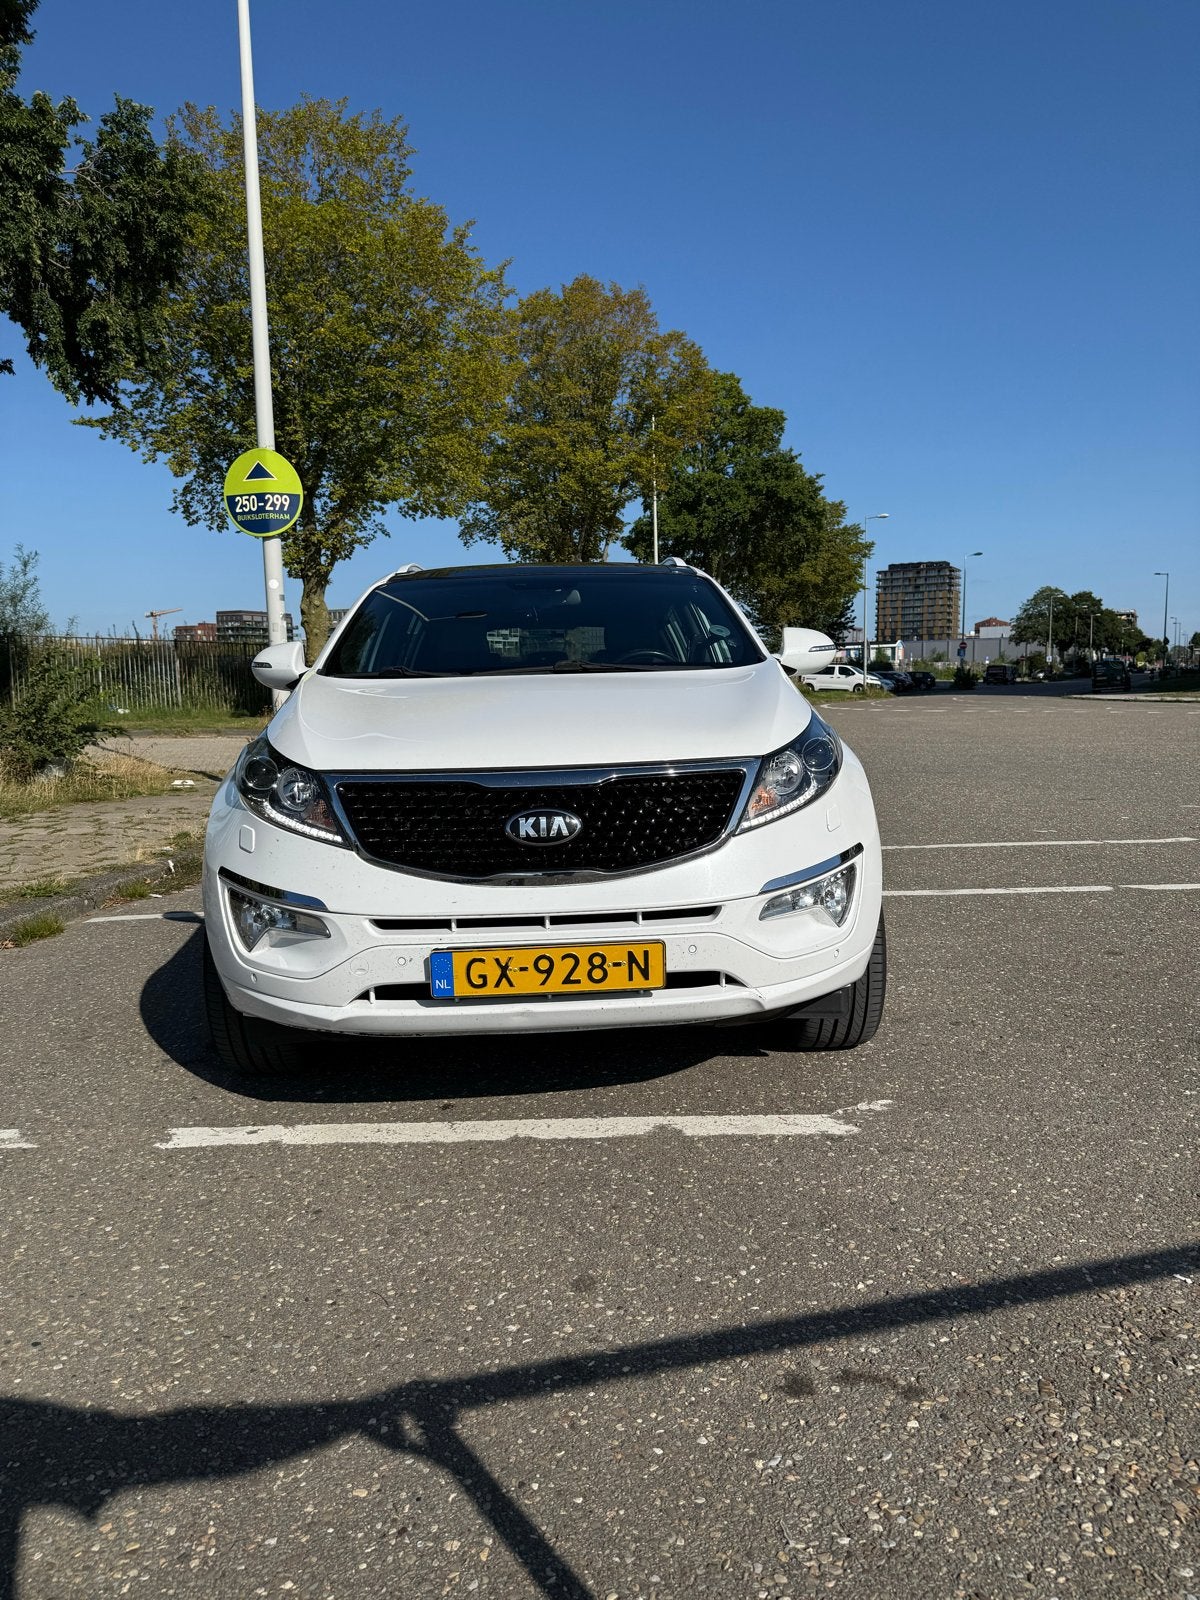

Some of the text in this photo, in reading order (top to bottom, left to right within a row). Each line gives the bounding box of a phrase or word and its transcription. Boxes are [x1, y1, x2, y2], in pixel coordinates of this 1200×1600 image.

[235, 493, 290, 513] 250-299
[237, 512, 290, 521] BUIKSLOTERHAM
[518, 816, 570, 838] KIA
[435, 949, 650, 989] NL GX-928-N
